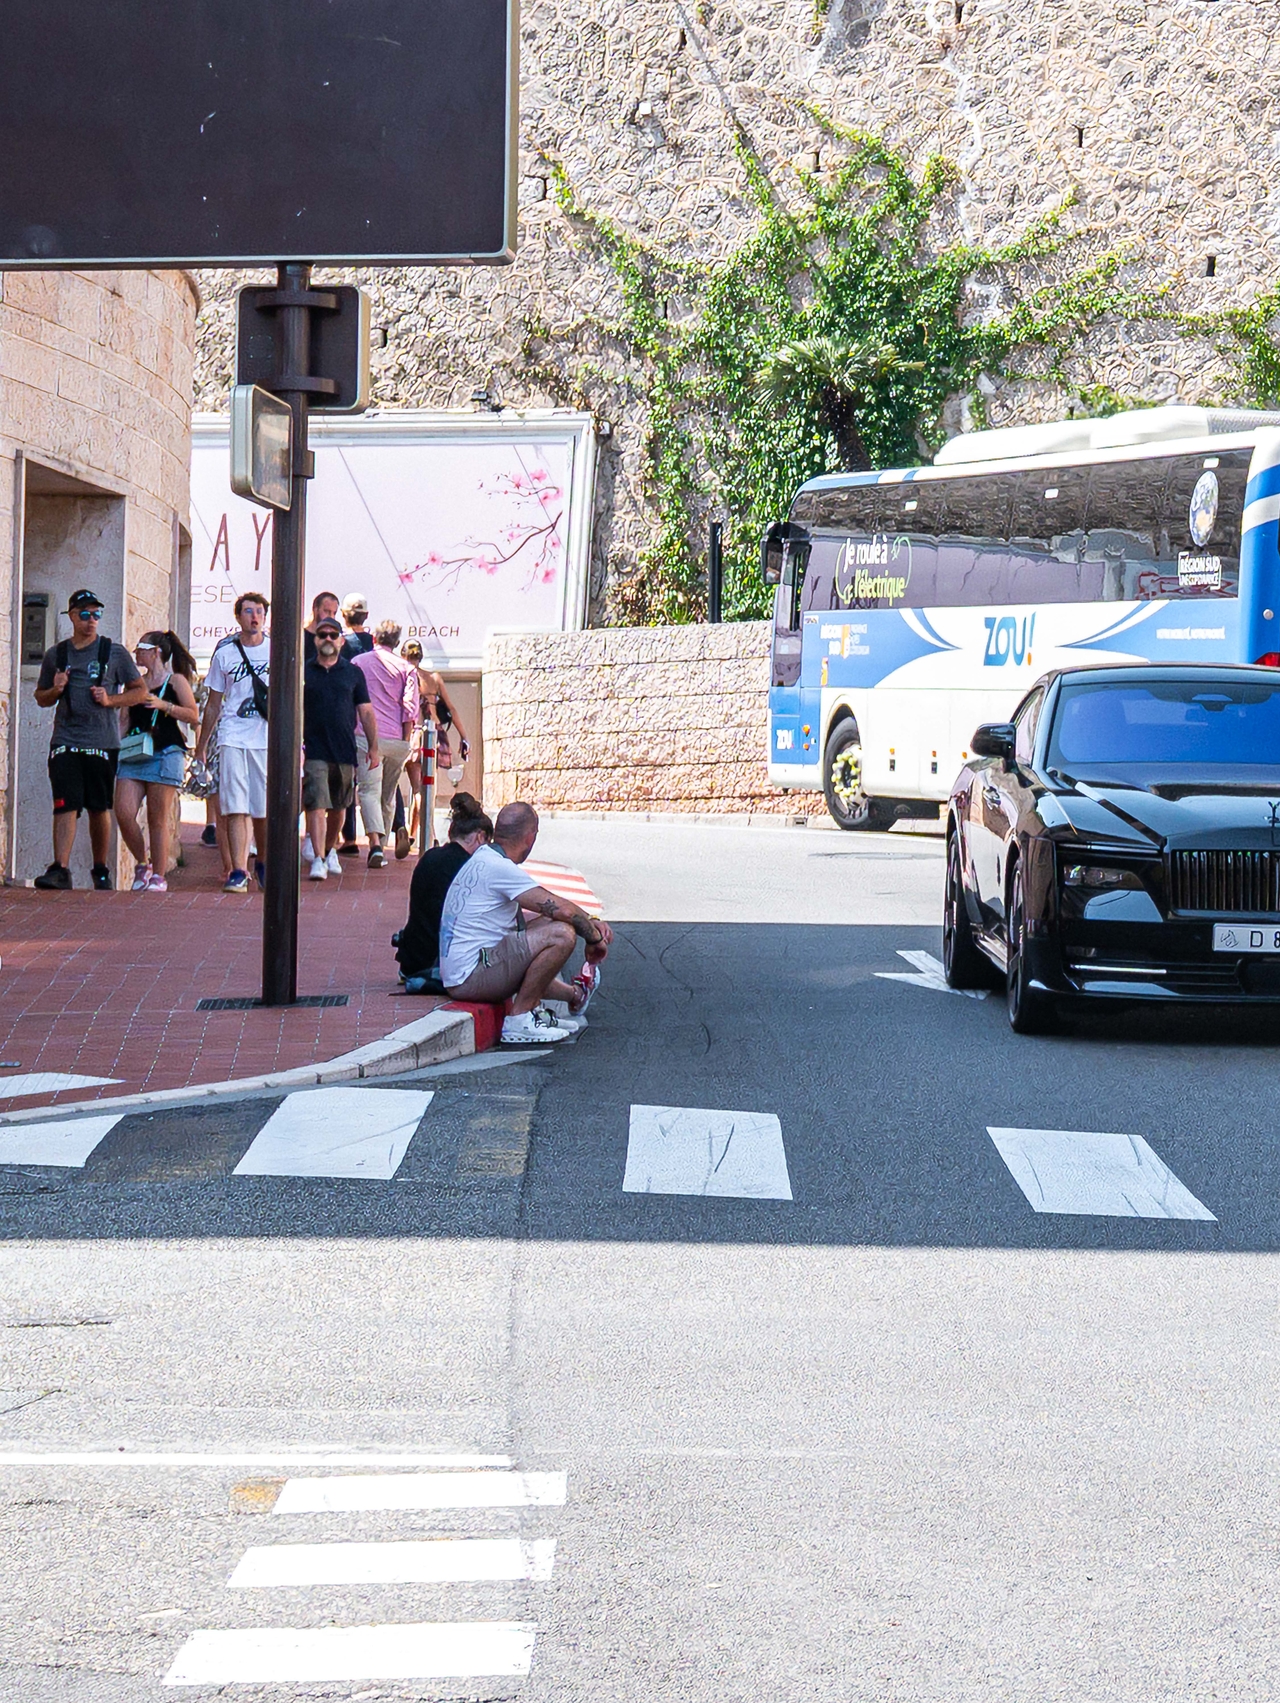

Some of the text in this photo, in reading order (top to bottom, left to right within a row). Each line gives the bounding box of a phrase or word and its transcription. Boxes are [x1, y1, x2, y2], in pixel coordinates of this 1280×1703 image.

[843, 534, 888, 573] Je roule à
[854, 569, 905, 607] l'électrique
[408, 626, 460, 637] BEACH
[983, 611, 1036, 666] ZOU!
[1250, 930, 1264, 948] D
